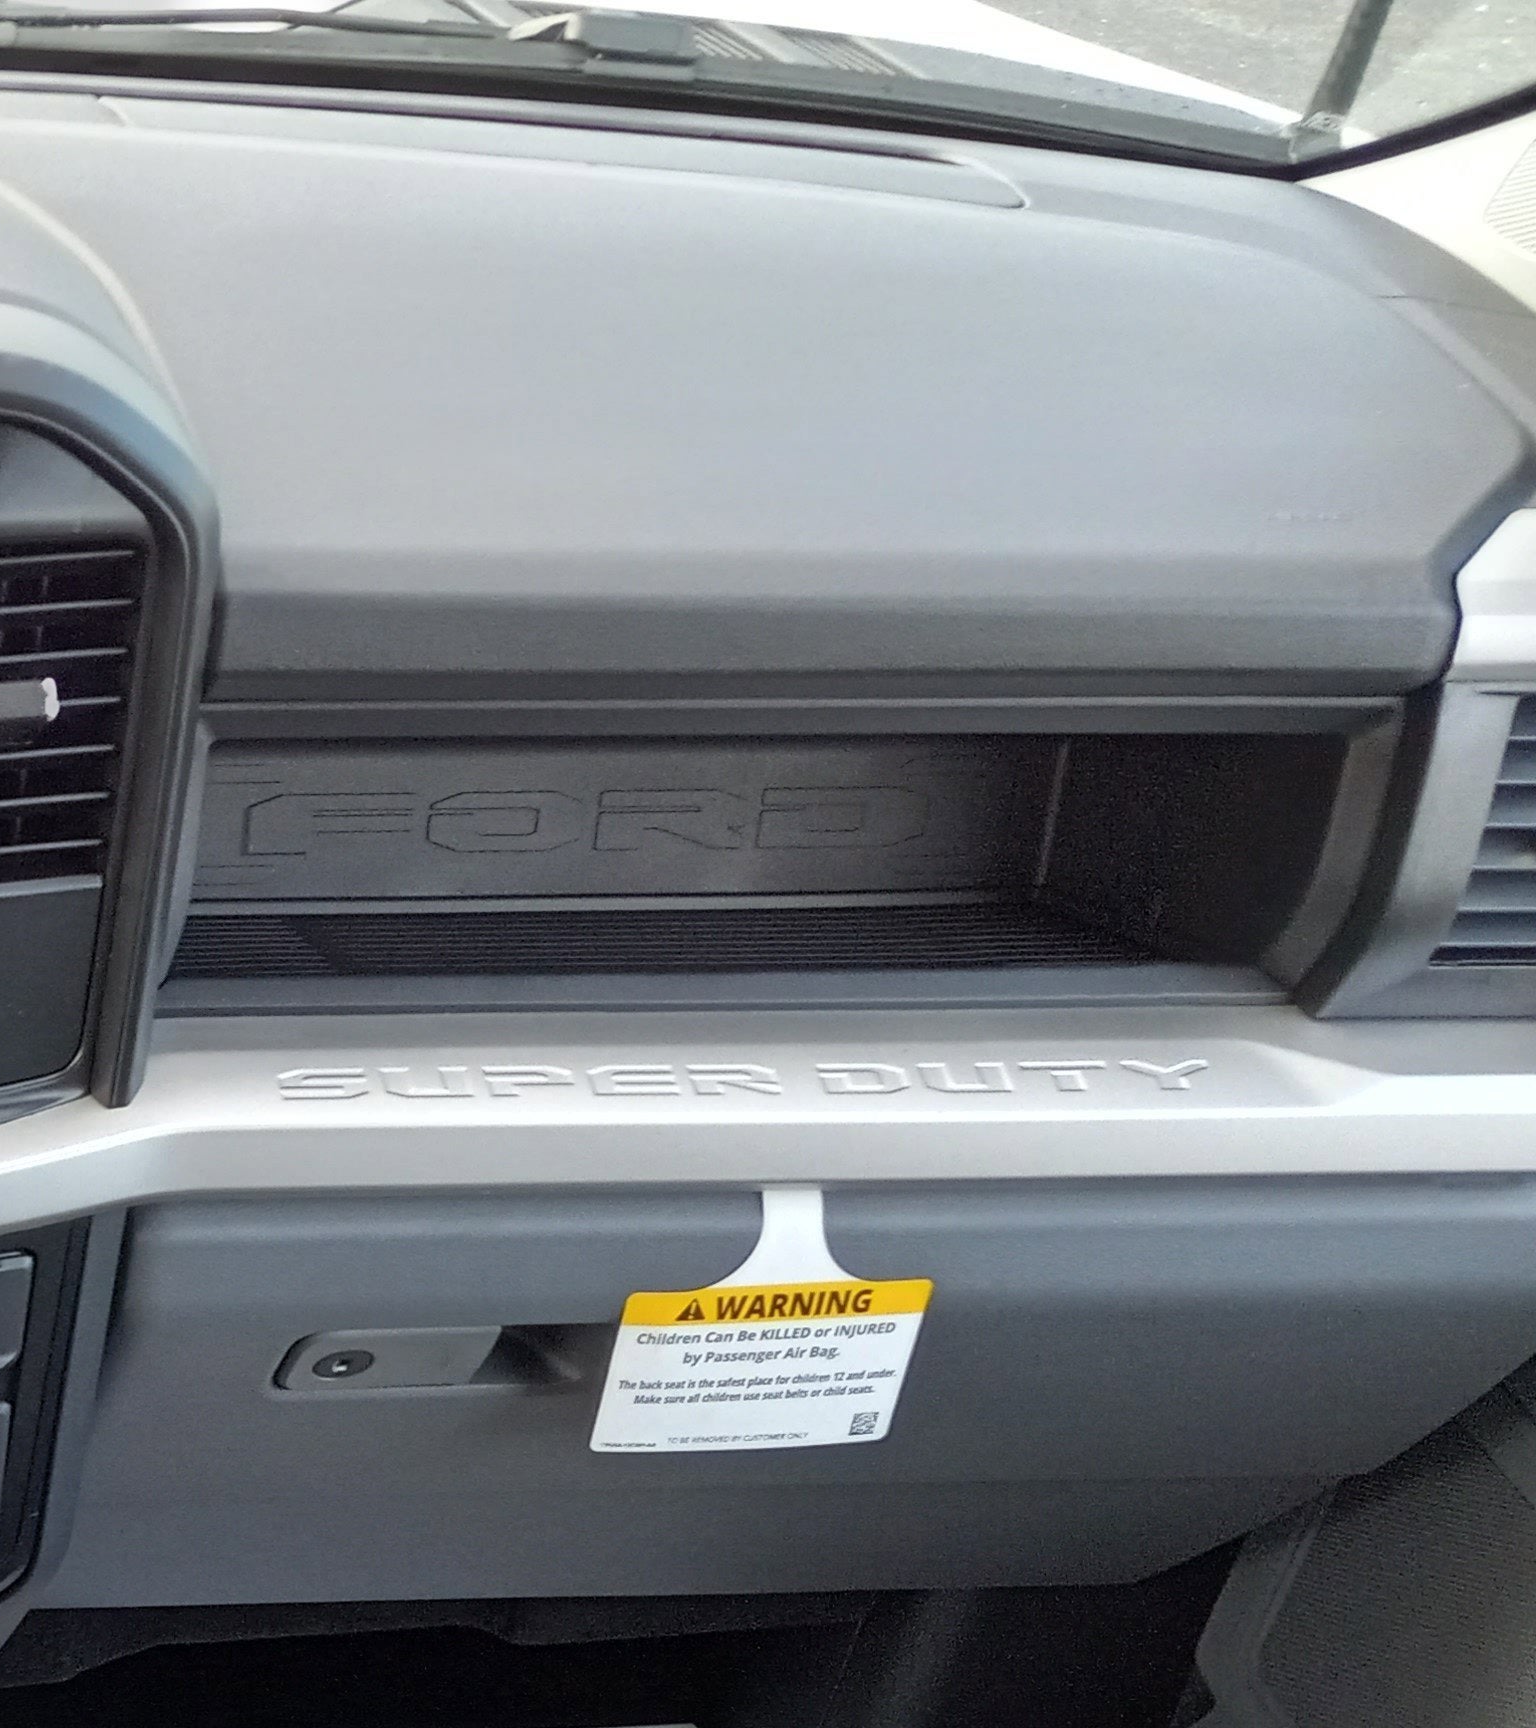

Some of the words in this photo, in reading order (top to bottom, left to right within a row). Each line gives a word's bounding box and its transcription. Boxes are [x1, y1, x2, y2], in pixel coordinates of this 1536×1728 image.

[239, 785, 924, 857] FORD
[275, 1063, 782, 1101] SUPER
[815, 1059, 1209, 1095] DUTY
[715, 1289, 873, 1320] WARNING
[637, 1333, 701, 1345] Children
[705, 1331, 733, 1343] Can
[737, 1330, 756, 1341] Be
[760, 1327, 811, 1340] KILLED
[814, 1327, 832, 1338] or
[834, 1322, 896, 1338] INJURED
[683, 1352, 702, 1366] by
[704, 1349, 781, 1364] Passenger
[783, 1347, 807, 1359] Air
[809, 1346, 840, 1359] Bag.
[619, 1380, 636, 1389] The
[639, 1379, 662, 1389] back
[664, 1380, 686, 1389] seat
[687, 1379, 696, 1389] is
[699, 1379, 714, 1388] the
[716, 1377, 745, 1387] safest
[747, 1377, 773, 1388] place
[775, 1375, 790, 1385] for
[792, 1373, 830, 1384] children
[846, 1370, 865, 1380] and
[633, 1395, 659, 1404] Make
[660, 1396, 685, 1404] sure
[688, 1393, 700, 1403] all
[702, 1393, 741, 1402] children
[744, 1393, 760, 1401] use
[762, 1391, 783, 1400] seat
[823, 1386, 847, 1396] child
